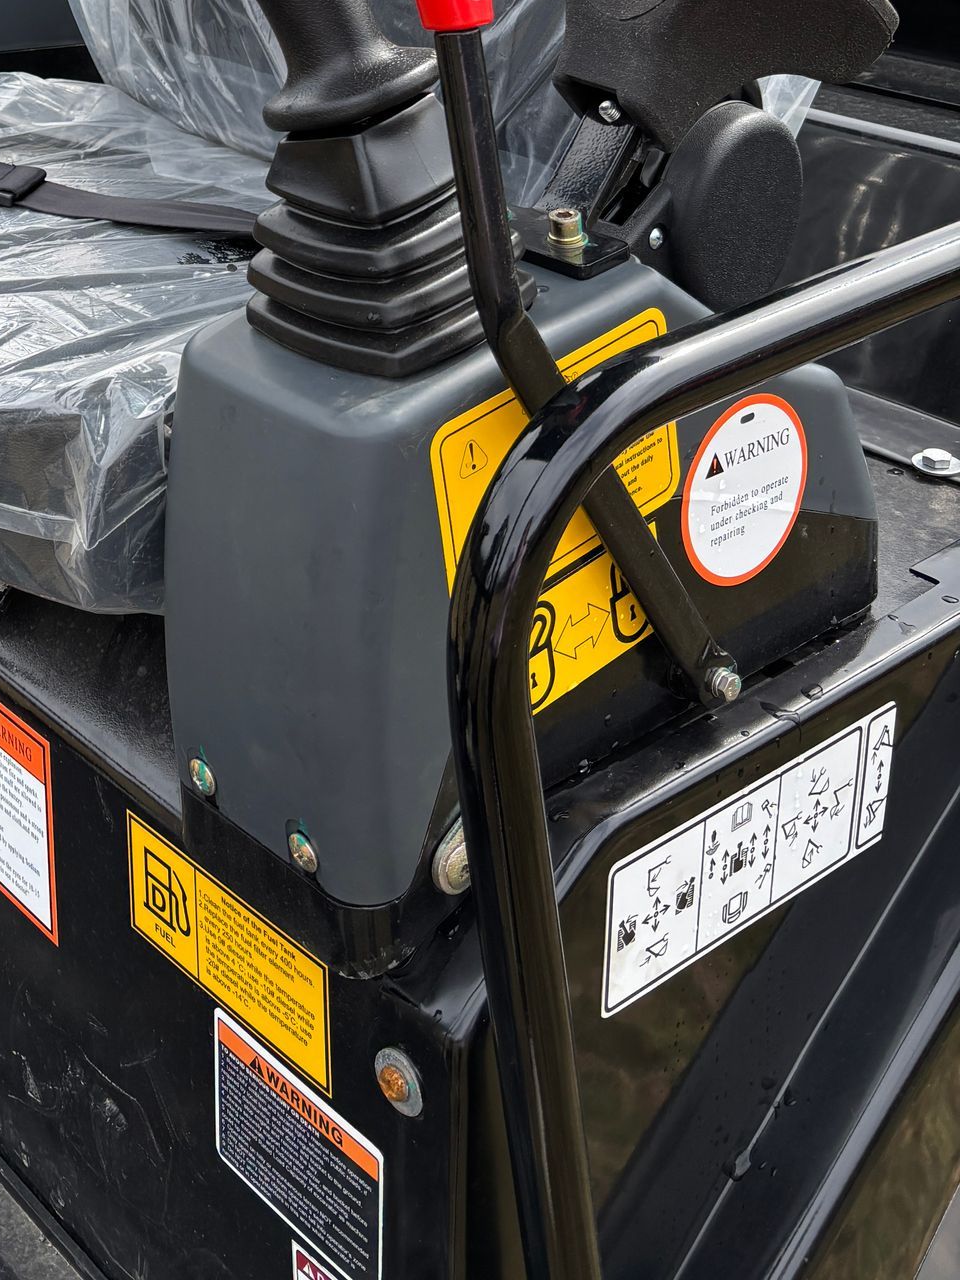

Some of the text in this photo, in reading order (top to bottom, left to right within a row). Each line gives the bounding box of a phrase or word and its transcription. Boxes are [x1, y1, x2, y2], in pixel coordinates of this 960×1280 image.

[625, 442, 656, 464] instructions
[631, 462, 639, 472] the
[641, 455, 653, 467] daily
[724, 428, 790, 468] WARNING
[628, 476, 637, 486] and
[711, 476, 788, 516] Forbidden to operate
[710, 491, 783, 532] under checking and
[710, 525, 745, 547] repairing
[155, 923, 176, 948] FUEL
[204, 915, 220, 933] every
[222, 928, 233, 943] 250
[221, 896, 296, 961] Notice of the Fuel Tank
[222, 908, 232, 921] the
[233, 917, 245, 932] fuel
[246, 927, 259, 944] tank
[260, 941, 278, 960] every
[280, 955, 292, 970] 400
[229, 925, 239, 938] the
[240, 933, 252, 948] fuel
[253, 944, 267, 960] filter
[268, 958, 294, 983] element
[205, 936, 210, 945] is
[212, 942, 230, 961] above
[247, 972, 259, 985] use
[276, 996, 295, 1016] diesel
[297, 1013, 314, 1031] while
[205, 945, 215, 959] the
[216, 955, 253, 991] temperature
[254, 986, 260, 996] is
[261, 993, 281, 1013] above
[300, 1025, 312, 1039] use
[206, 966, 211, 976] is
[212, 973, 231, 992] above
[226, 944, 245, 963] diesel
[246, 960, 262, 977] while
[263, 973, 274, 987] the
[275, 983, 315, 1021] temperature
[220, 970, 239, 989] diesel
[240, 986, 256, 1003] while
[257, 999, 267, 1013] the
[268, 1009, 308, 1047] temperature
[221, 1044, 228, 1054] TO
[266, 1066, 343, 1147] WARNING
